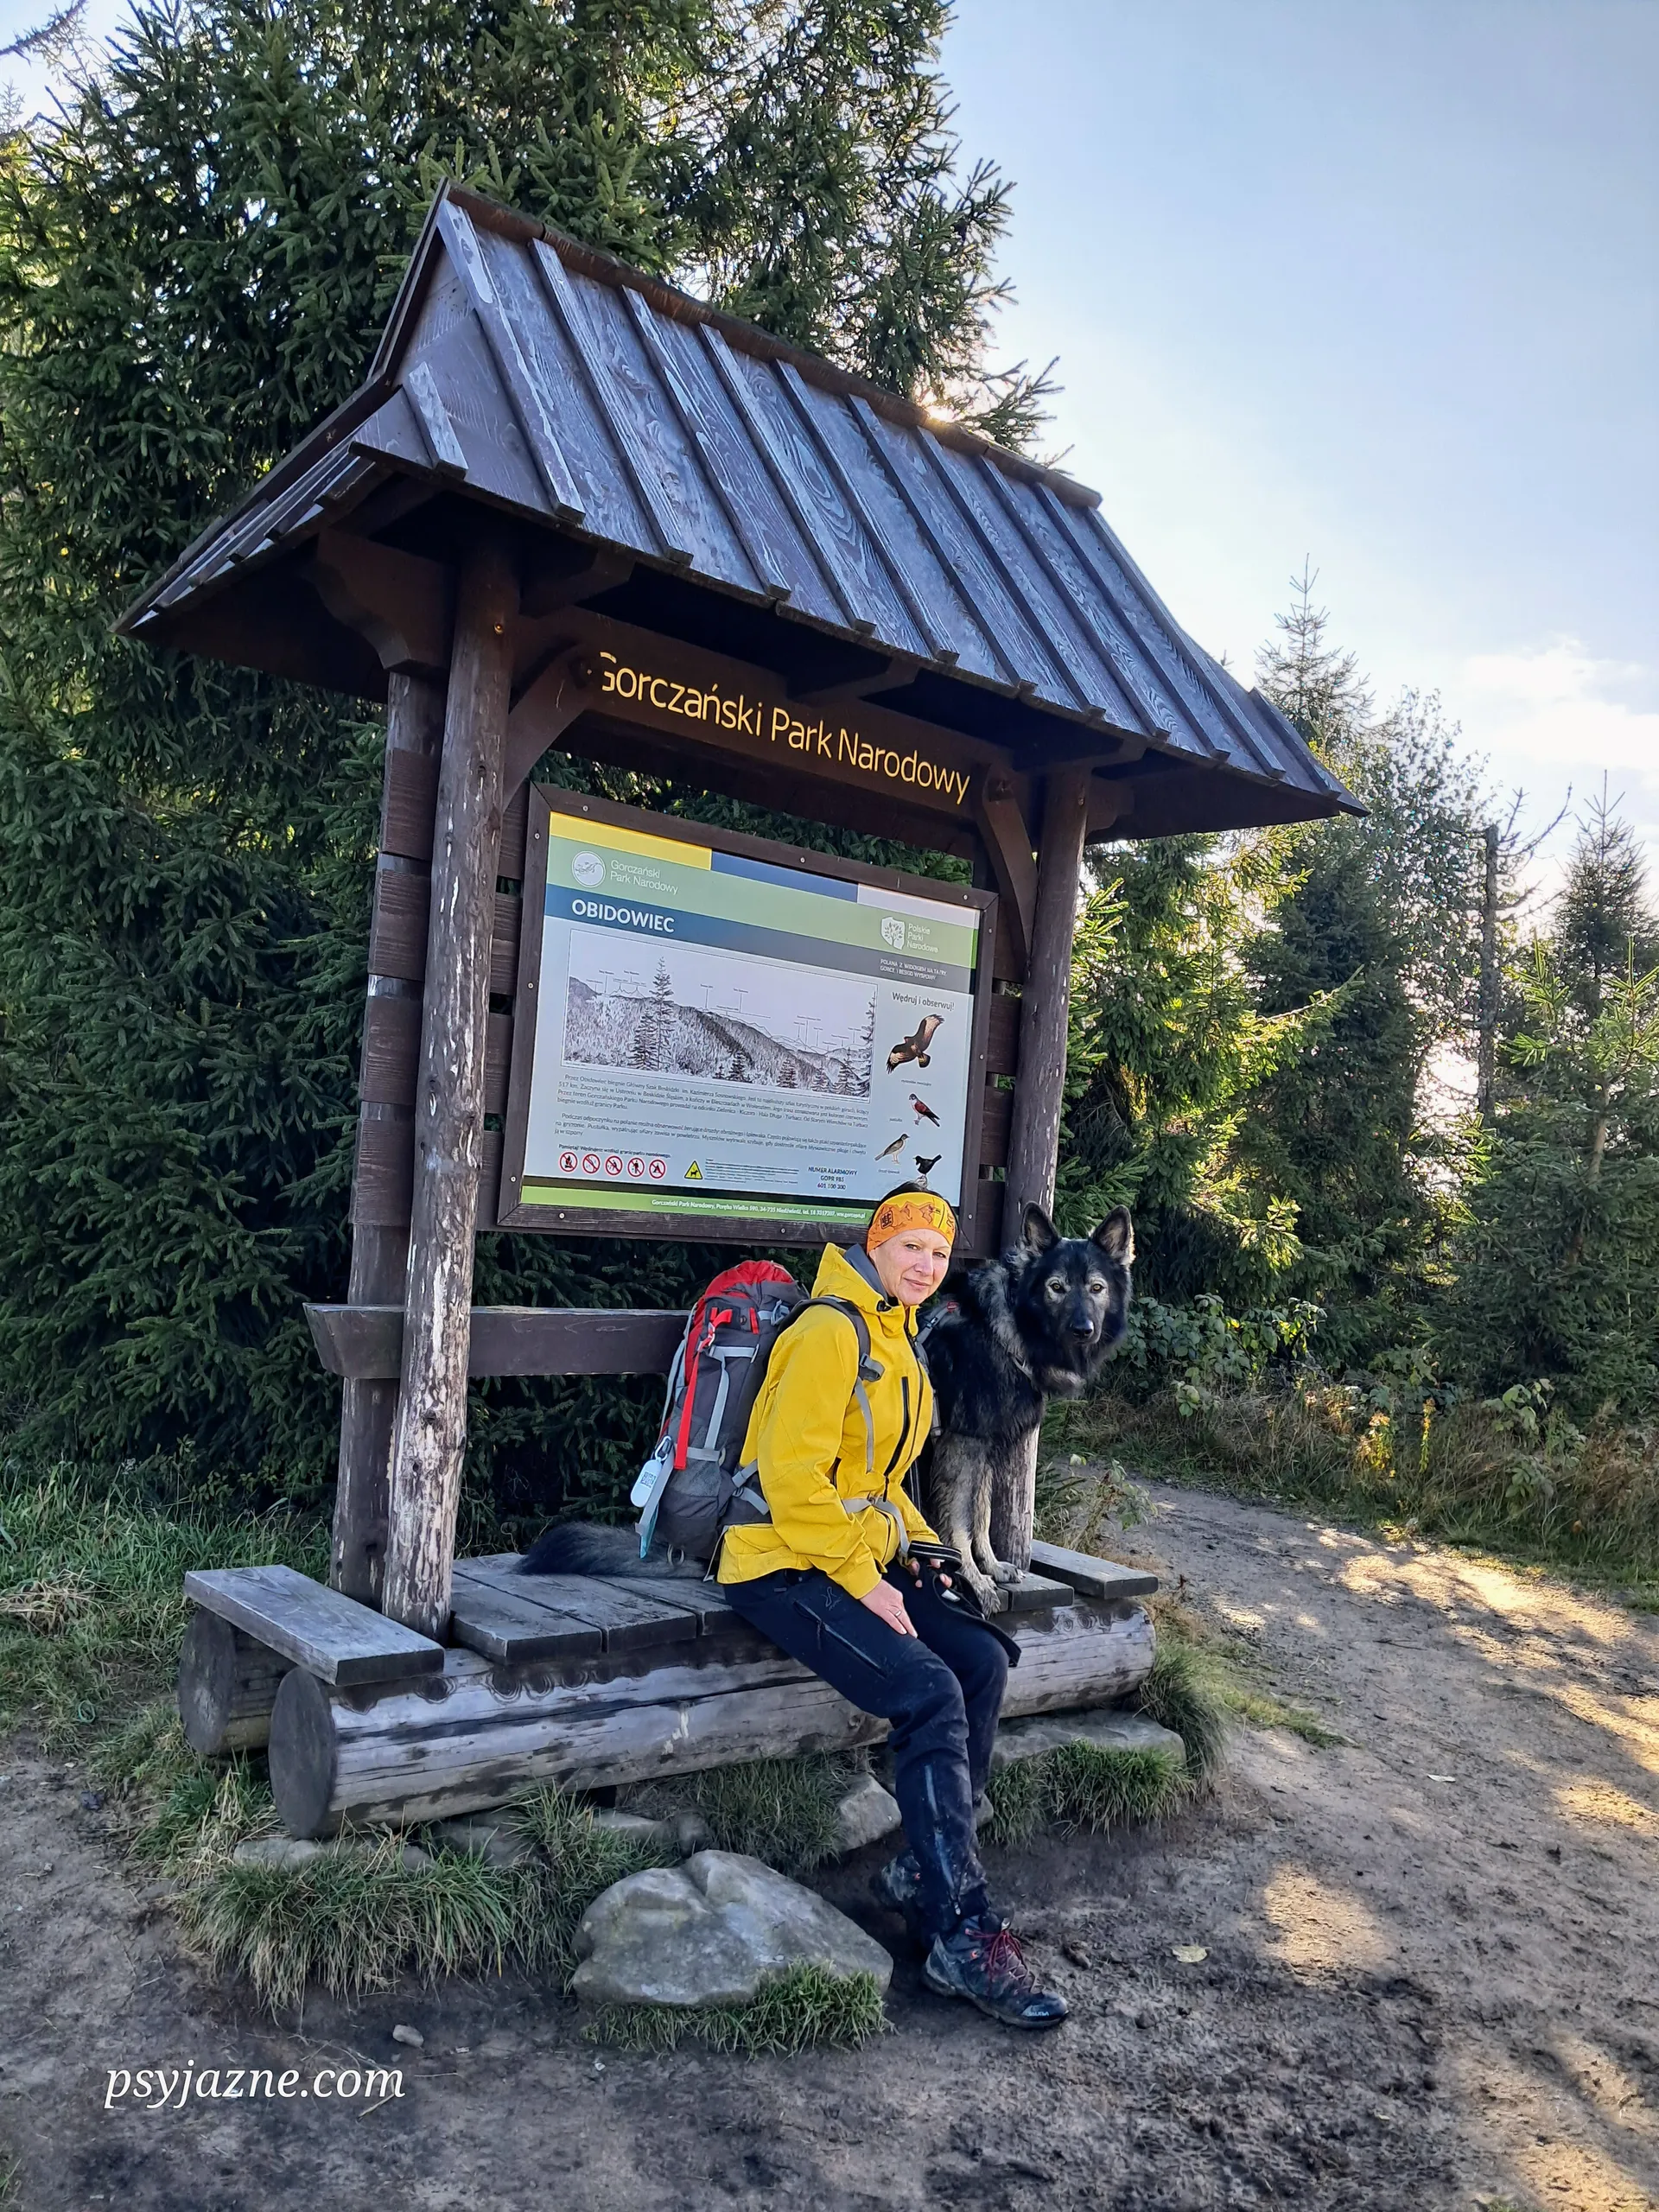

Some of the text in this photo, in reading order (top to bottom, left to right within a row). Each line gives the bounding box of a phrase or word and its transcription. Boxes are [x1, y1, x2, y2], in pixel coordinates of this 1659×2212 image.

[771, 707, 833, 759] Park
[838, 728, 971, 804] Narodowy
[611, 860, 660, 878] Gorczański
[610, 871, 678, 895] Park Narodowy
[571, 899, 675, 933] OBIDOWIEC
[907, 931, 924, 941] Parki
[908, 923, 931, 935] Polskie
[906, 941, 938, 953] Narodowe
[892, 992, 917, 1005] Wędruj
[922, 998, 955, 1011] obserwuj!
